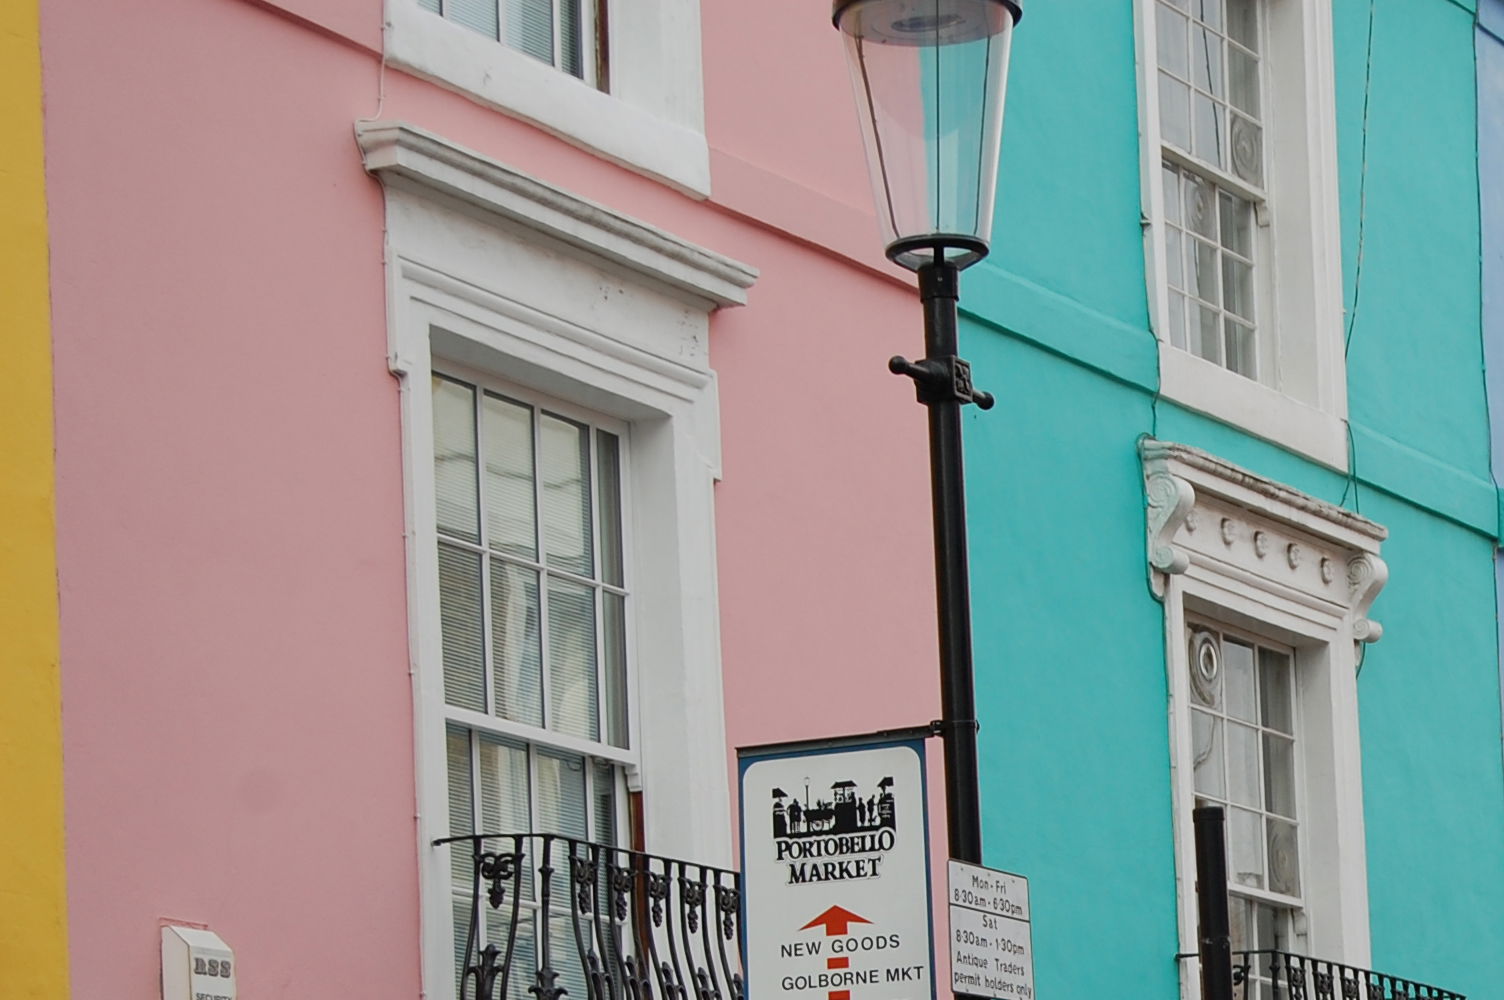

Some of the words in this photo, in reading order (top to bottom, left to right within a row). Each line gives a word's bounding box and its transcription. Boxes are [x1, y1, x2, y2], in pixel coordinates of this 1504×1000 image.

[776, 830, 895, 861] PORTOBELLO
[788, 857, 882, 884] MARKET
[972, 875, 989, 889] Mon
[995, 881, 1007, 894] Fri
[982, 914, 998, 930] Sat
[781, 941, 821, 958] NEW
[831, 934, 900, 953] GOODS
[956, 951, 988, 970] Antique
[994, 958, 1025, 977] Traders
[782, 969, 879, 990] GOLBORNE
[886, 965, 924, 982] MKT
[954, 971, 981, 986] permit
[984, 975, 1014, 993] holders
[1016, 984, 1032, 1000] only
